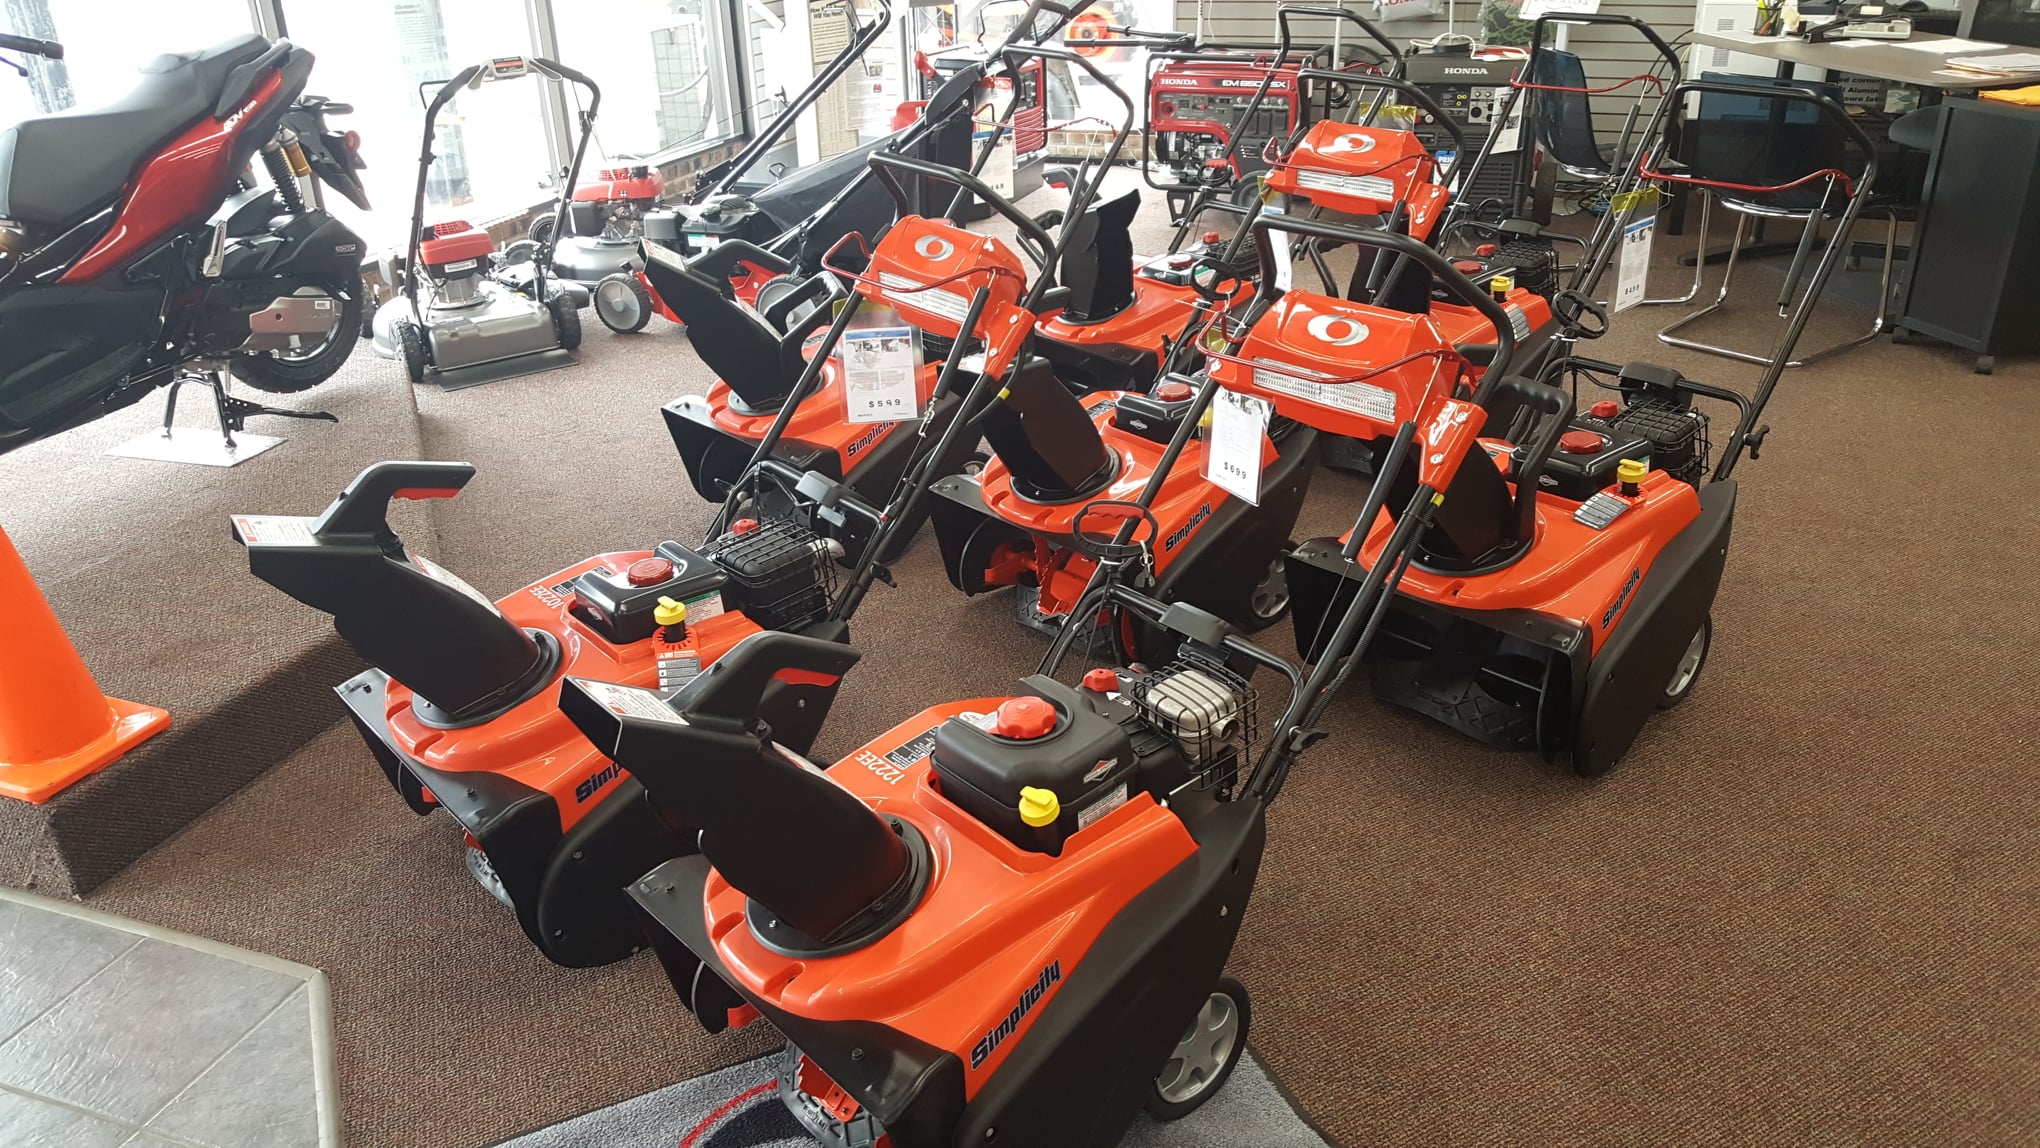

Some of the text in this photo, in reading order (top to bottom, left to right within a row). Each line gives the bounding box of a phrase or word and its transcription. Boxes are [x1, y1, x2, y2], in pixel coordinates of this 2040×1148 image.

[1161, 78, 1198, 86] HONDA
[1444, 67, 1488, 75] HONDA
[868, 398, 901, 408] $599
[1224, 461, 1247, 480] $699
[1165, 502, 1212, 552] Simplicity
[529, 585, 565, 610] 1022EE
[1602, 566, 1641, 631] Simplicity
[854, 750, 905, 785] 1222EE
[970, 957, 1063, 1071] Simplicity
